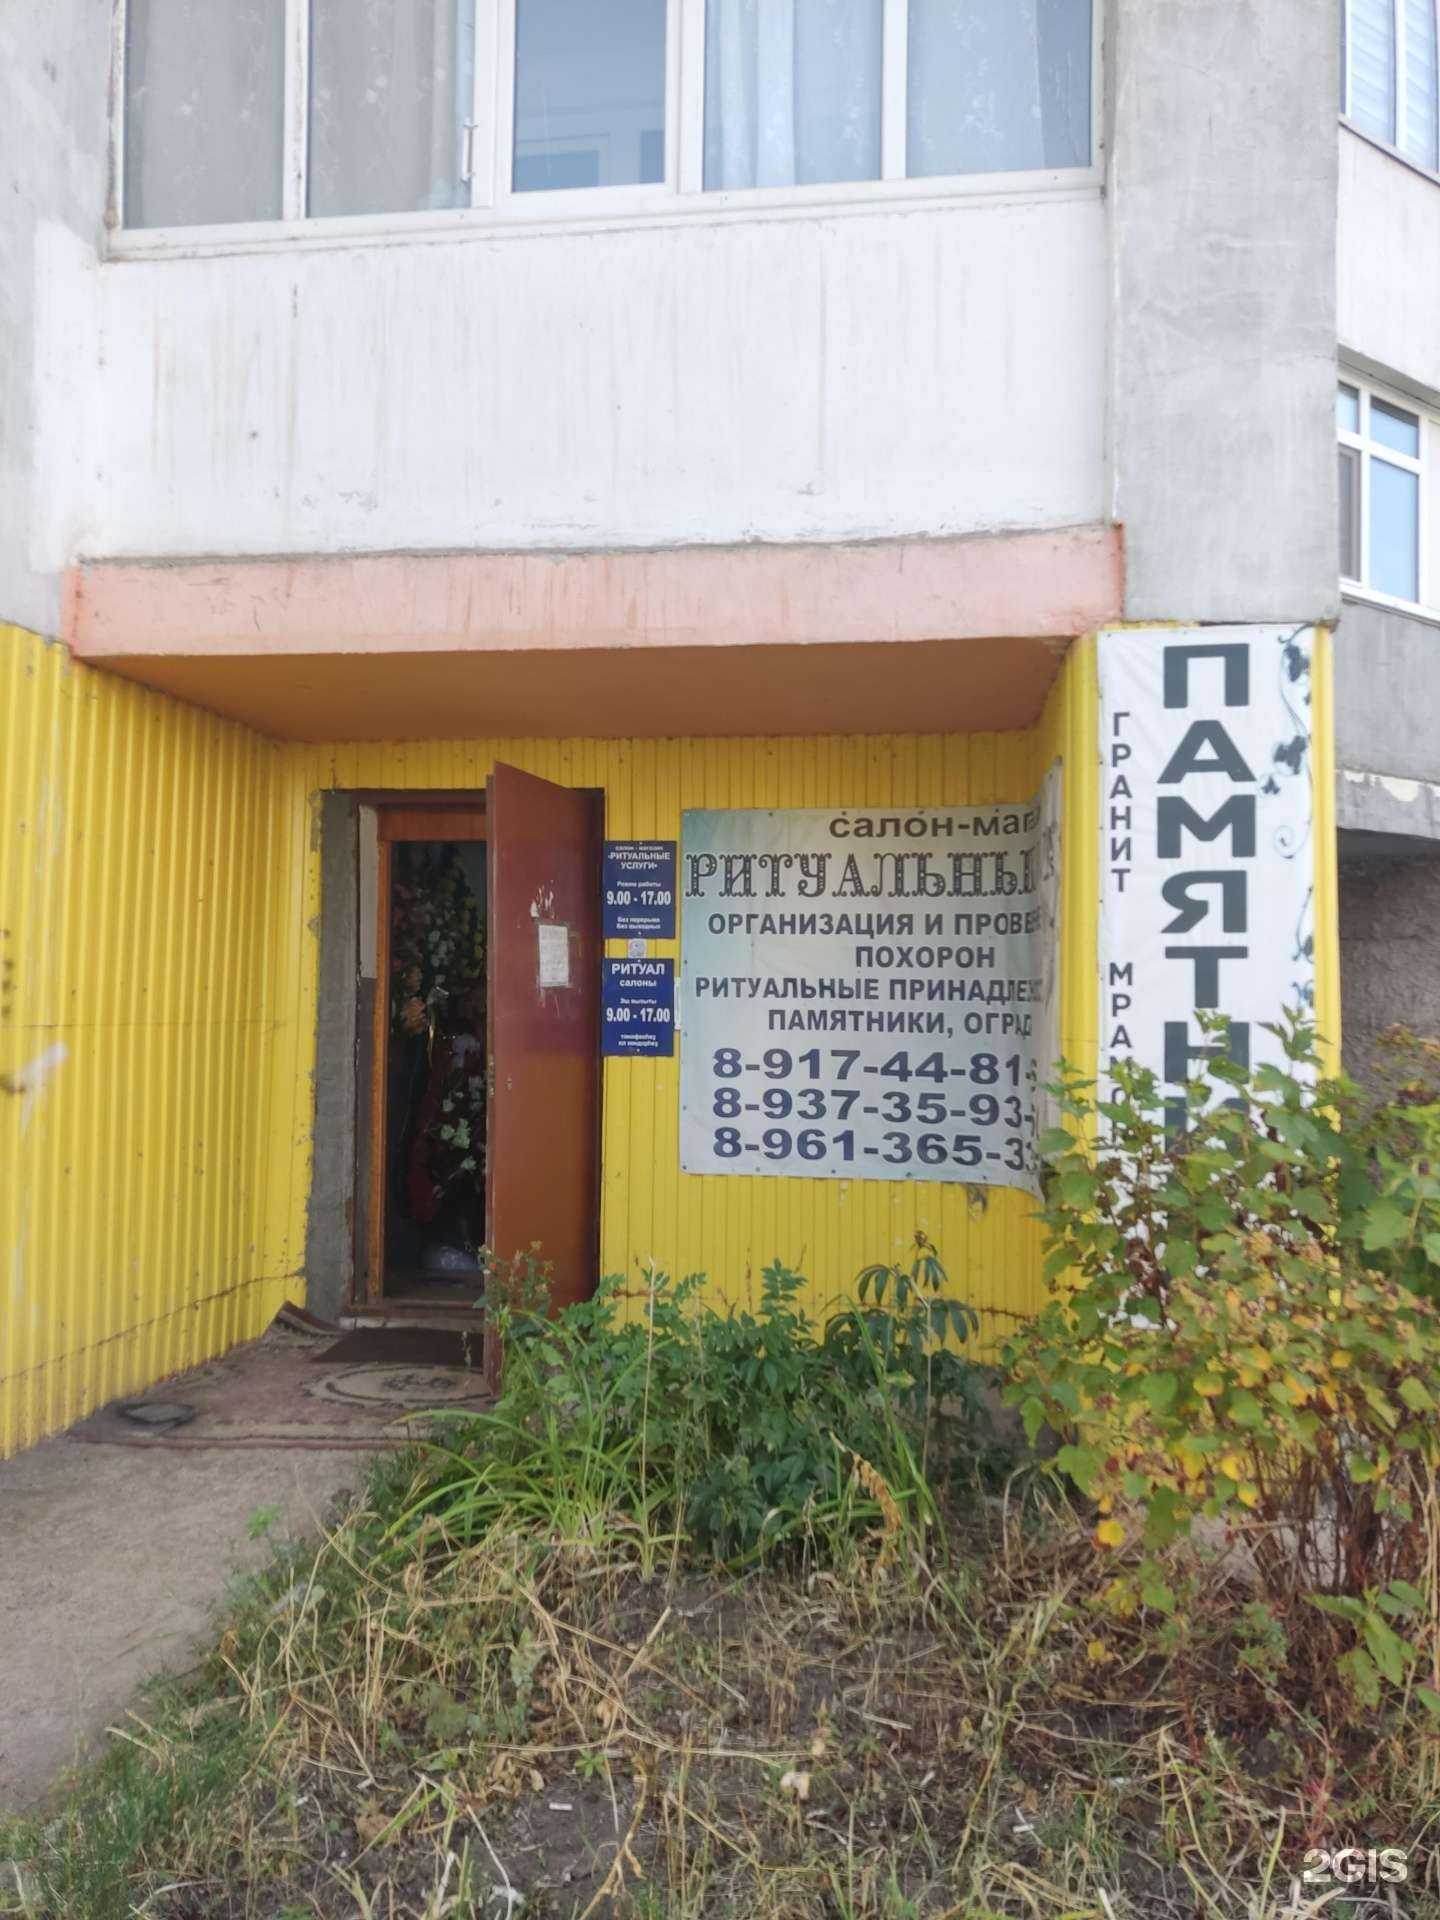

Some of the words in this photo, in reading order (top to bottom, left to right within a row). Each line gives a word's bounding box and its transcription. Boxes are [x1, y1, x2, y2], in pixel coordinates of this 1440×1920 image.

[1109, 711, 1132, 893] ГРАНИТ
[606, 891, 631, 906] 9.00
[640, 891, 671, 906] 17.00
[708, 913, 914, 939] ОРГАНИЗАЦИЯ
[925, 914, 943, 935] И
[856, 946, 995, 968] ПОХОРОН
[612, 963, 665, 975] РИТУАЛ
[695, 977, 879, 1001] РИТУАЛЬНЫЕ
[606, 1007, 631, 1022] 9.00
[640, 1007, 671, 1022] 17.00
[768, 1009, 953, 1038] ПАМЯТНИКИ,
